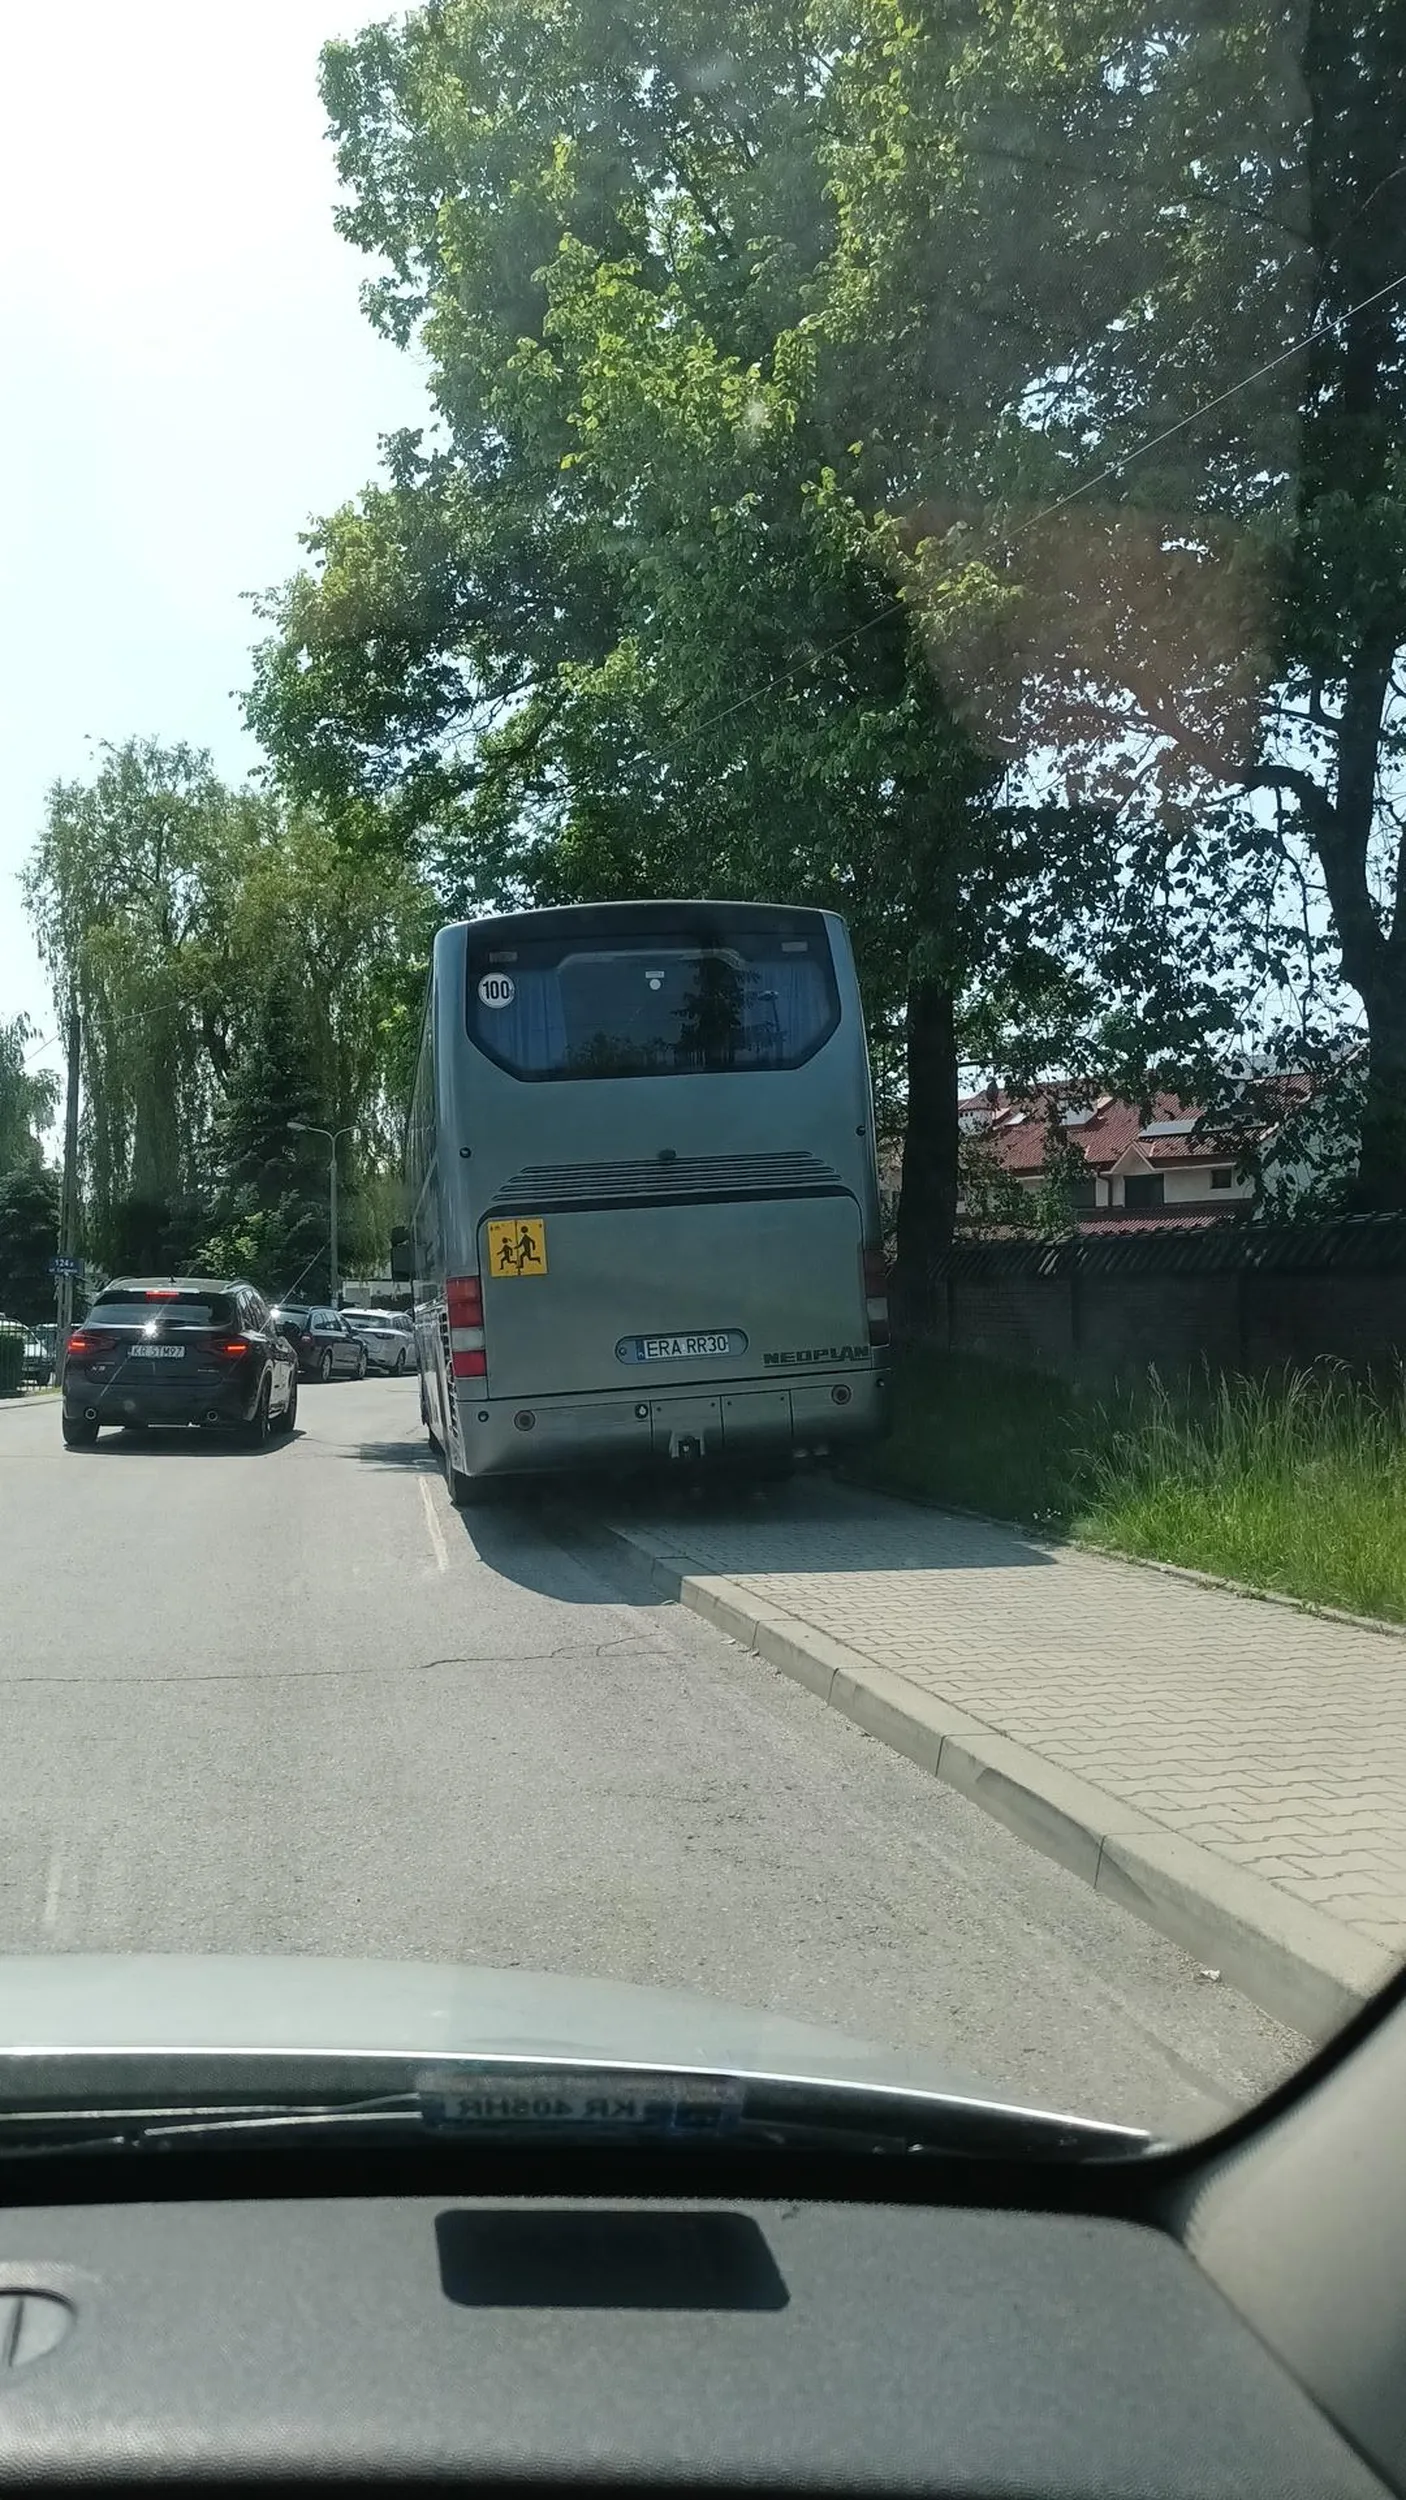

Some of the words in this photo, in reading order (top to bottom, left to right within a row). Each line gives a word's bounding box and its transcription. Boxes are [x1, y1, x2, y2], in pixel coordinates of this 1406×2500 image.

[482, 980, 510, 1000] 100
[133, 1344, 147, 1357] KR
[646, 1339, 682, 1358] ERA
[686, 1335, 727, 1354] RR30
[763, 1345, 870, 1365] NEOPLAN
